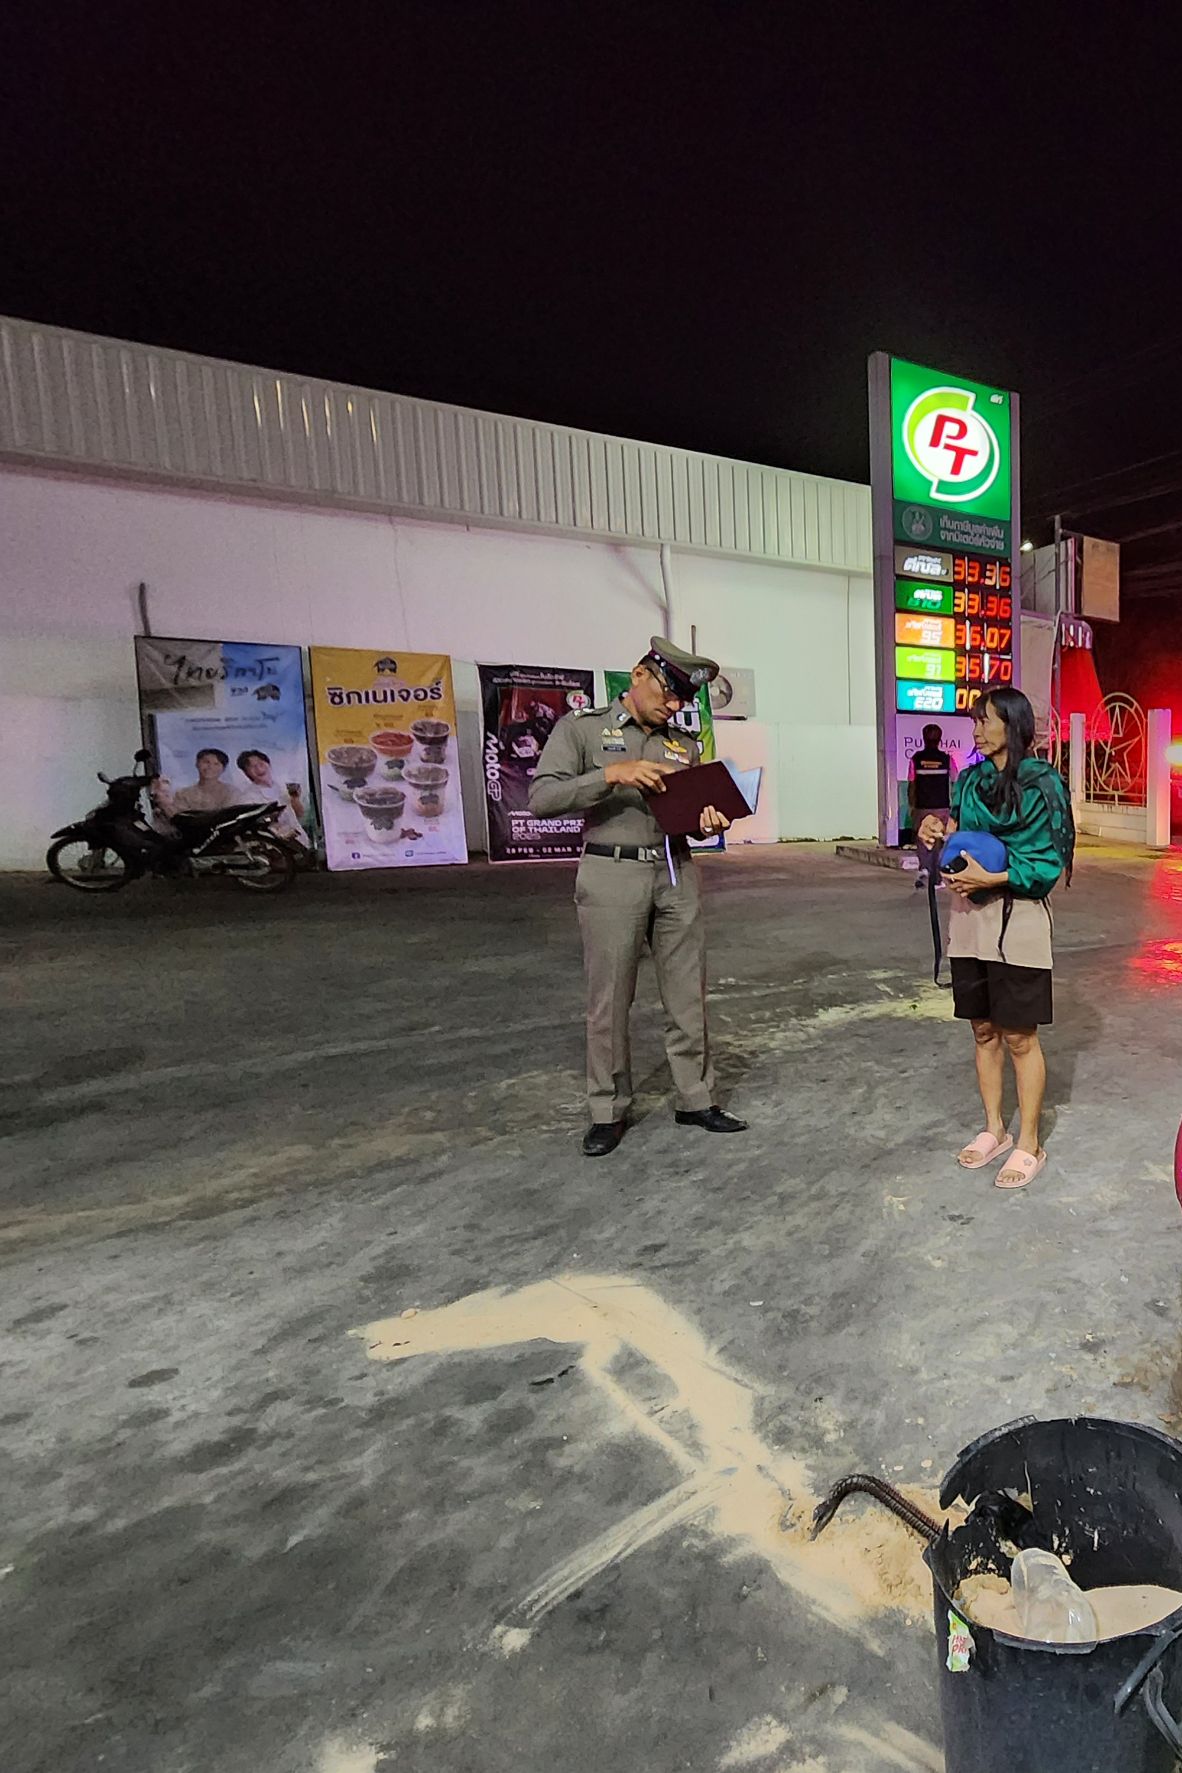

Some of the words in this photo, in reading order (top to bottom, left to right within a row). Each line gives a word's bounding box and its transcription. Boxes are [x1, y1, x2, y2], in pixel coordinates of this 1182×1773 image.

[929, 414, 979, 475] PT
[954, 559, 1010, 587] 33.36
[954, 591, 1011, 619] 33.36
[326, 681, 444, 707] ซิกเนเจอร์
[904, 737, 961, 750] PUHAI
[485, 732, 501, 801] MotoGP
[526, 819, 562, 828] GRAND
